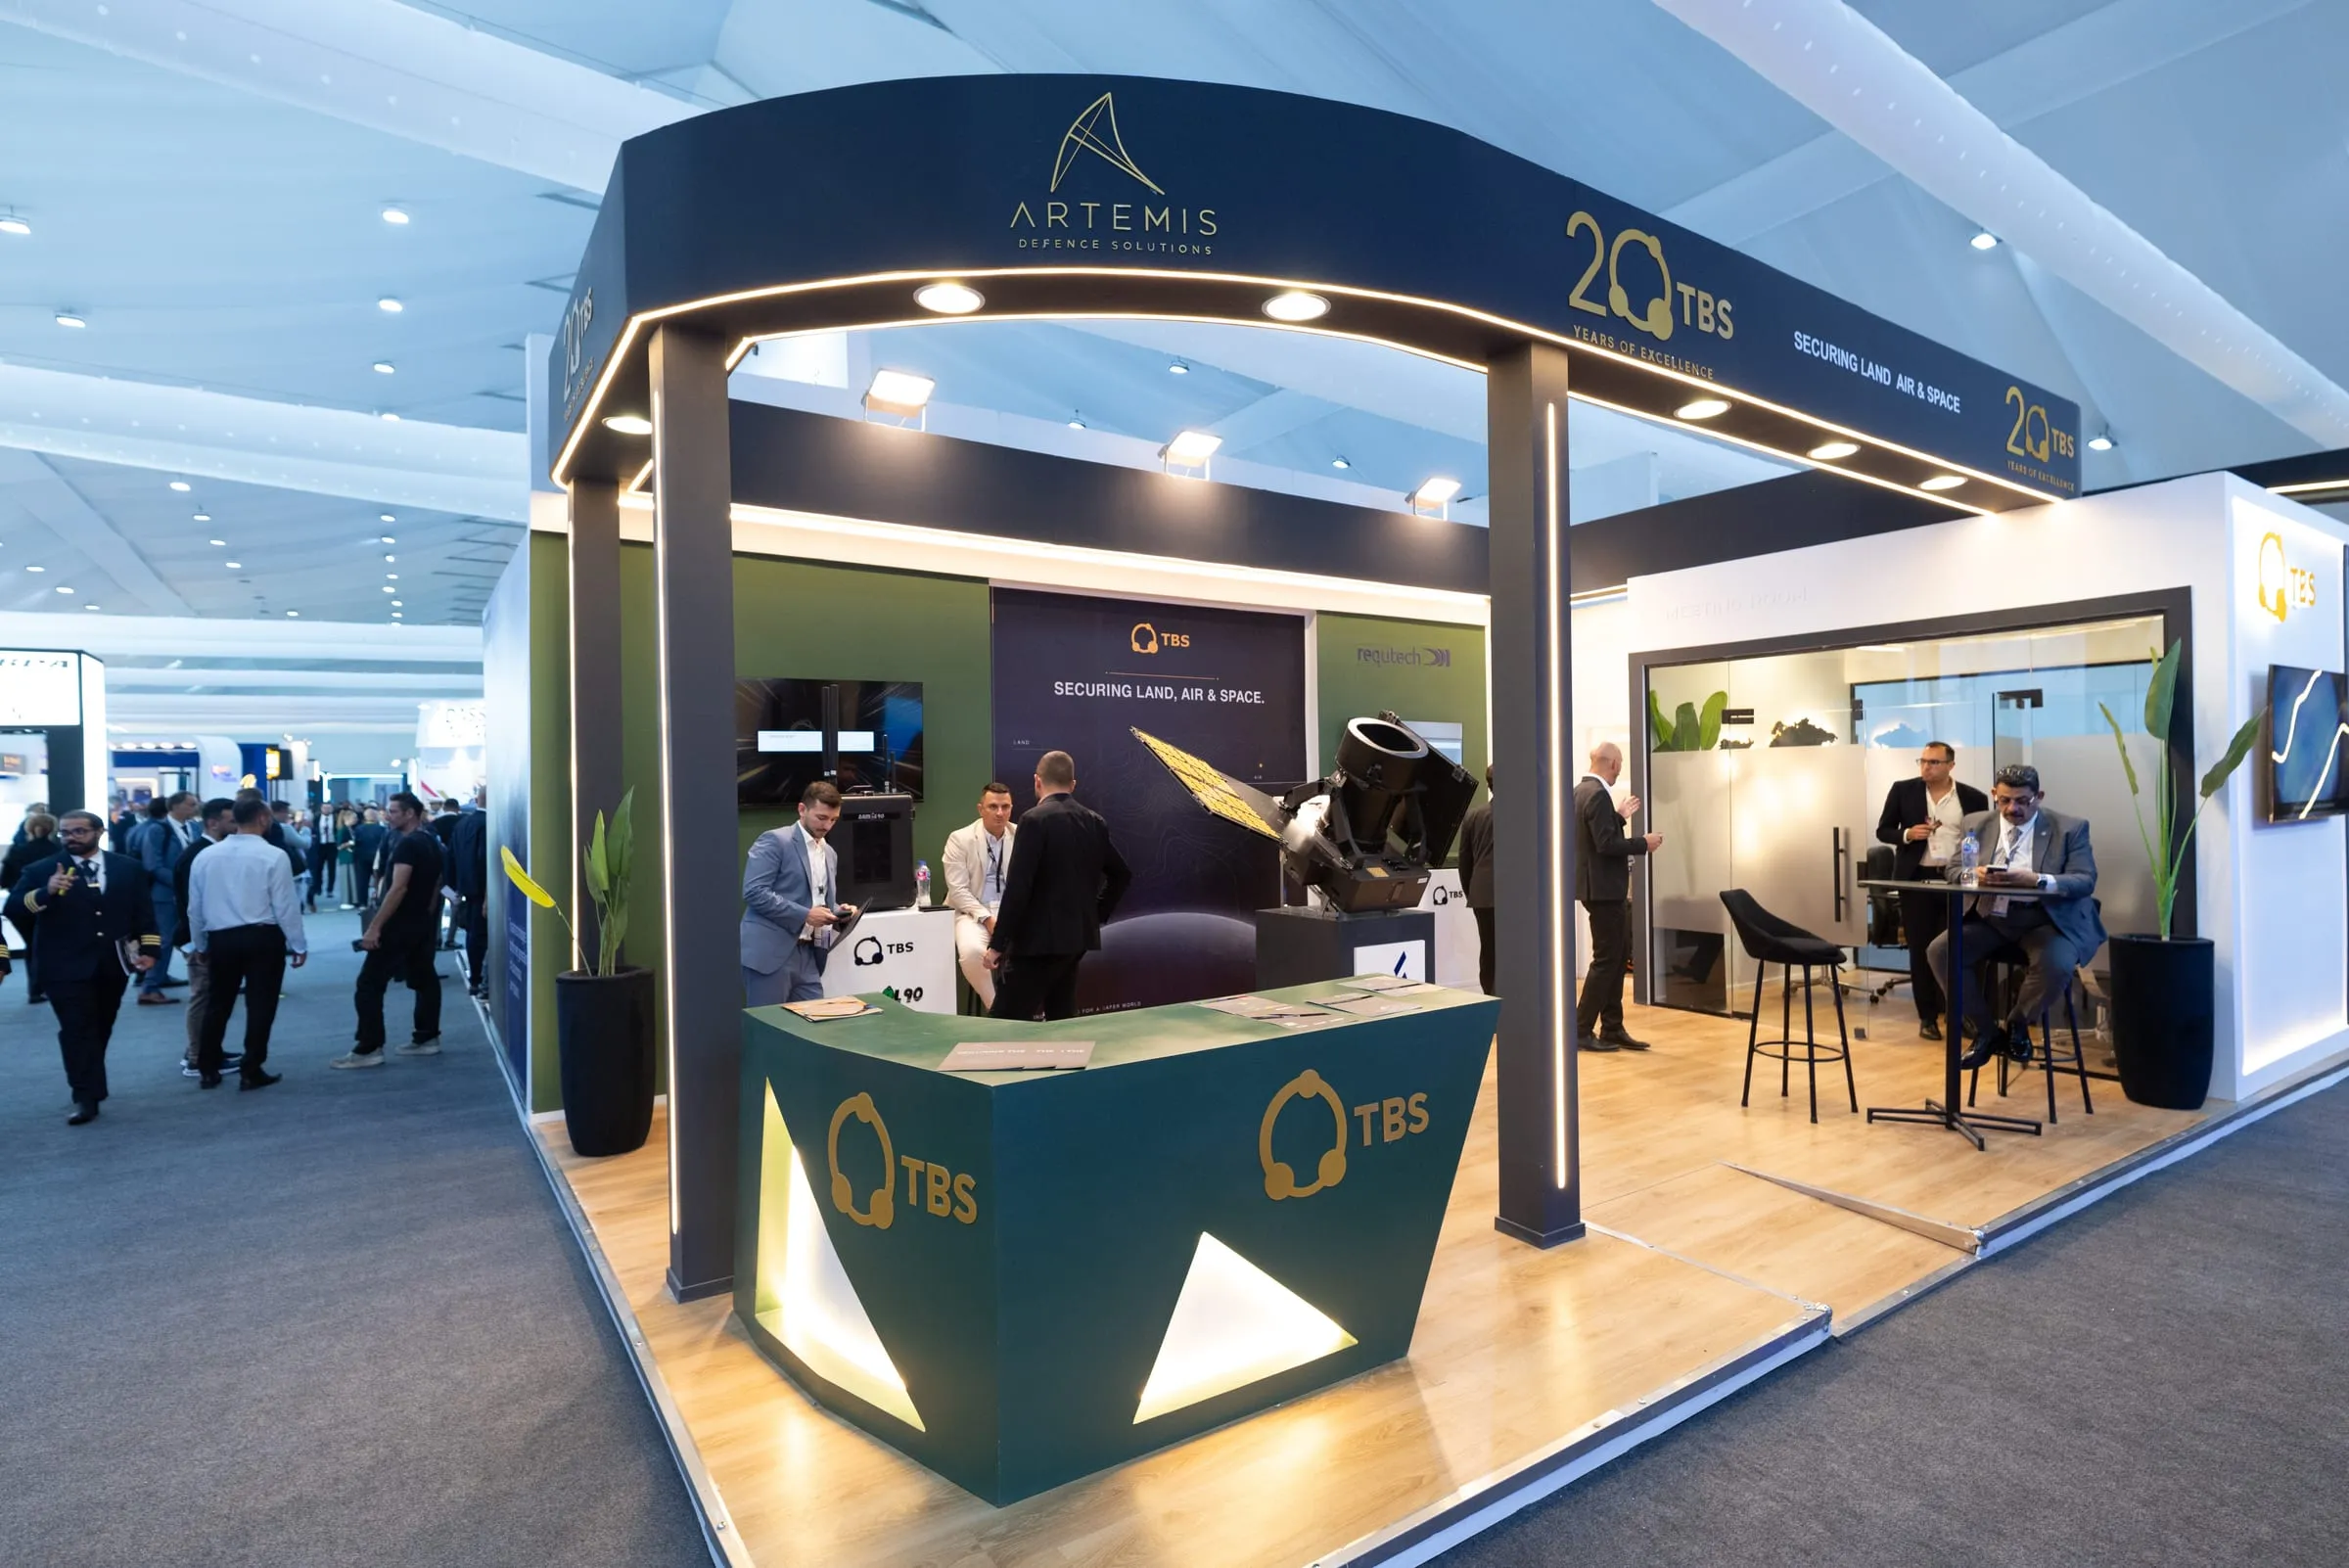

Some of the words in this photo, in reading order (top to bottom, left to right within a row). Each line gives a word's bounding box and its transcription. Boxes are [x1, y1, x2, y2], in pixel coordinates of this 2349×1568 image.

[1009, 200, 1218, 236] ARTEMIS
[1018, 238, 1100, 250] DEFENCE
[1111, 240, 1213, 255] SOLUTIONS
[1676, 281, 1734, 340] TBS
[1573, 324, 1616, 349] YEARS
[1619, 340, 1636, 356] OF
[1640, 346, 1714, 381] EXCELLENCE
[1793, 330, 1859, 374] SECURING
[1860, 357, 1892, 387] LAND
[1895, 372, 1915, 396] AIR
[1916, 381, 1925, 399] &
[1926, 385, 1961, 414] SPACE
[2050, 427, 2075, 459] TBS
[1160, 632, 1190, 648] TBS
[1358, 647, 1421, 668] requtech
[1054, 681, 1132, 699] SECURING
[1136, 685, 1177, 703] LAND,
[1180, 688, 1204, 702] AIR
[1207, 689, 1217, 702] &
[1220, 689, 1266, 705] SPACE.
[887, 942, 914, 955] TBS
[1354, 1092, 1430, 1146] TBS
[900, 1154, 978, 1224] TBS
